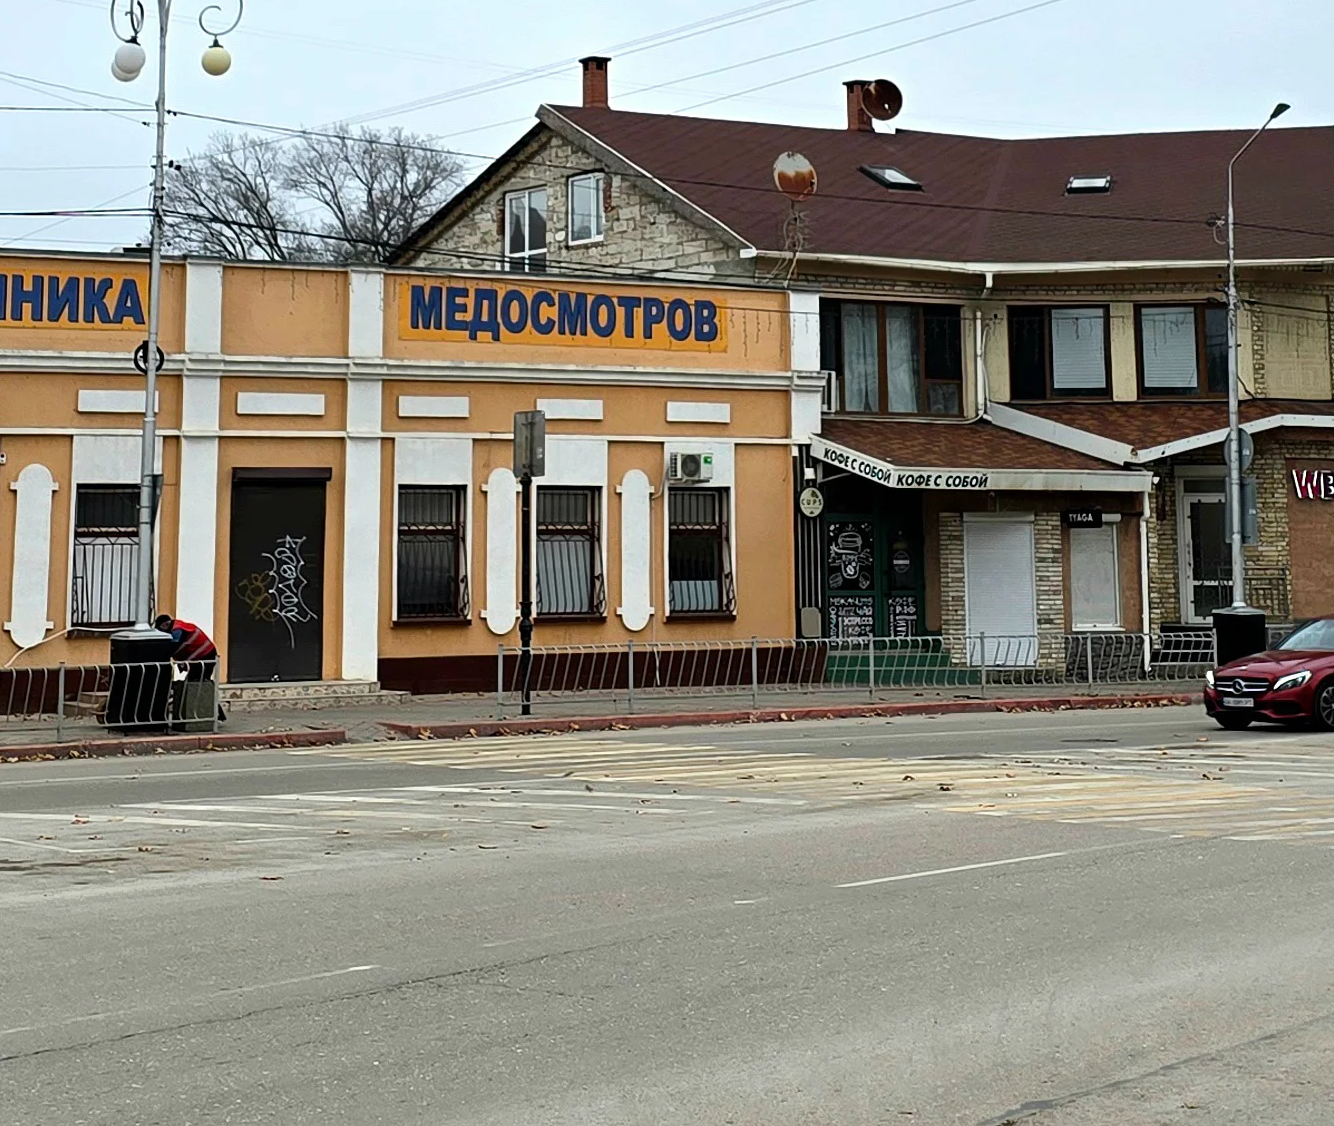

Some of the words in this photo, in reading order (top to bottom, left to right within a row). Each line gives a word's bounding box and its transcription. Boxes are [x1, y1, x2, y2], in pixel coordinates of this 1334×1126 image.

[410, 284, 719, 342] МЕДОСМОТРОВ
[823, 447, 850, 467] КОФЕ
[850, 458, 857, 471] С
[858, 461, 892, 484] СОБОЙ
[896, 474, 931, 487] КОФЕ
[933, 474, 942, 487] С
[945, 473, 989, 488] СОБОЙ
[801, 498, 822, 506] CUPS
